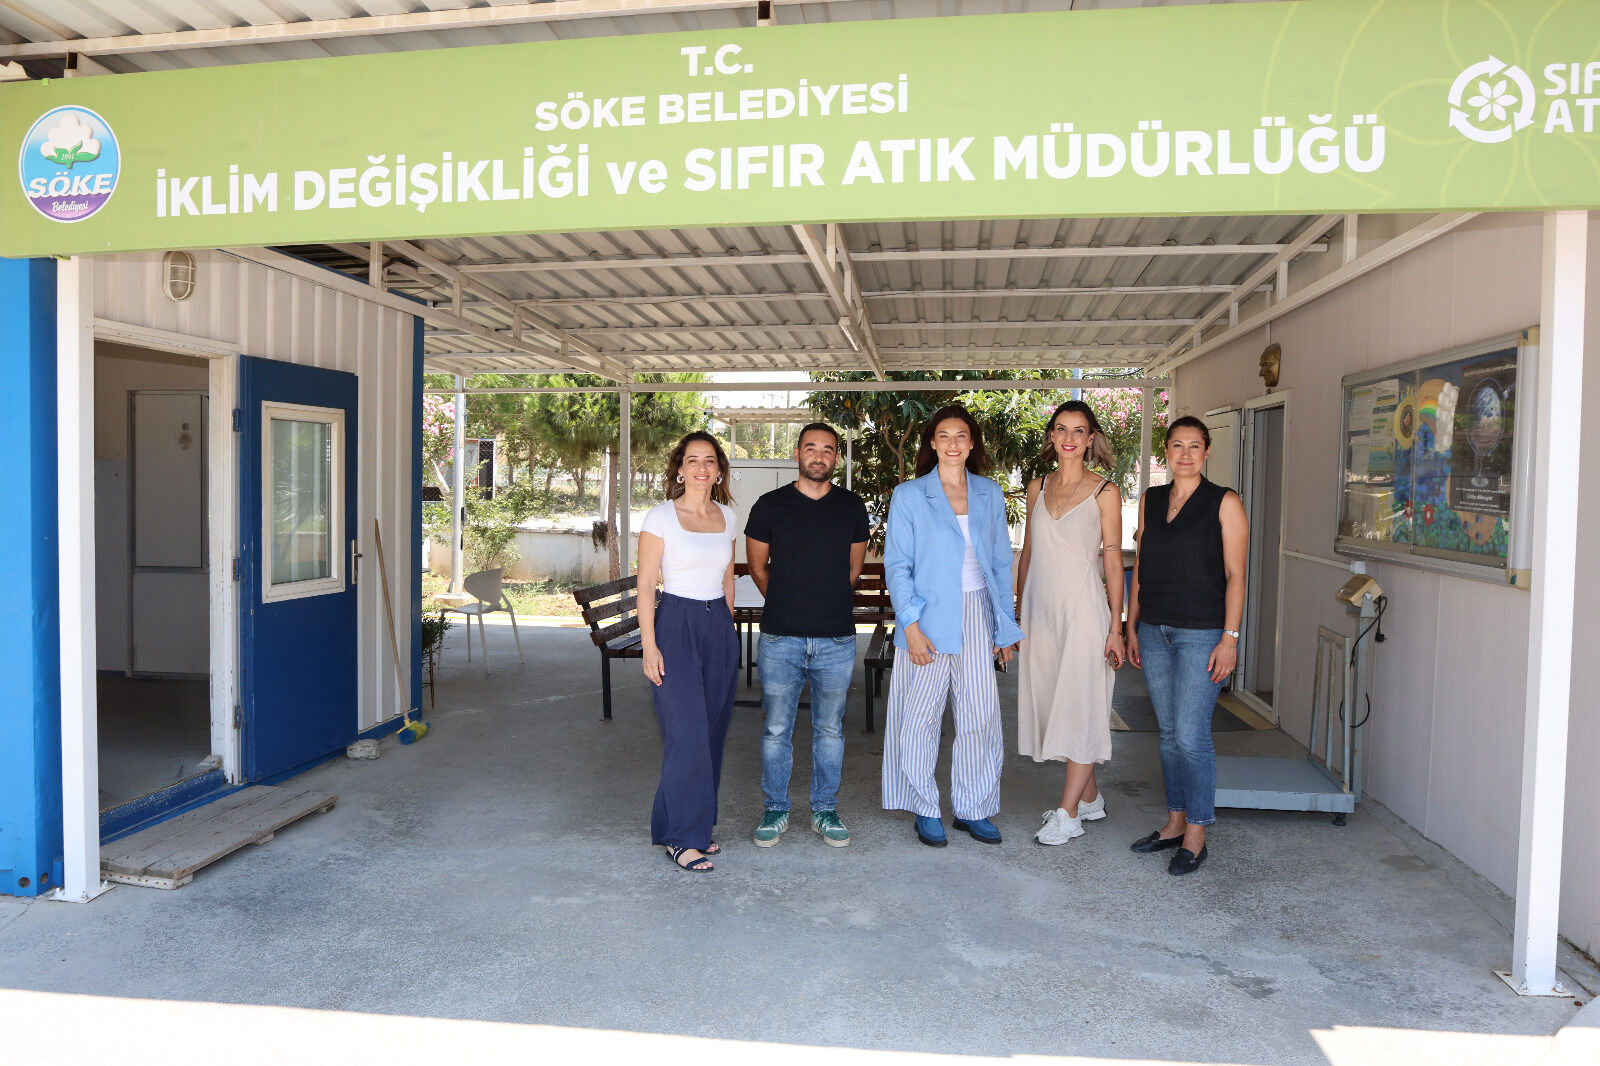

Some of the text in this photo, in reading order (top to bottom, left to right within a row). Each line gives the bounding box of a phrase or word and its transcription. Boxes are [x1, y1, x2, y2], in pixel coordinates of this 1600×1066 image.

[681, 43, 754, 77] T.C.
[534, 73, 908, 132] SÖKE BELEDİYESİ
[1543, 98, 1600, 134] AT
[156, 113, 1386, 218] İKLİM DEĞİŞİKLİĞİ ve SIFIR ATIK MÜDÜRLÜĞÜ
[28, 172, 113, 198] SÖKE
[51, 200, 89, 213] Belediyesi
